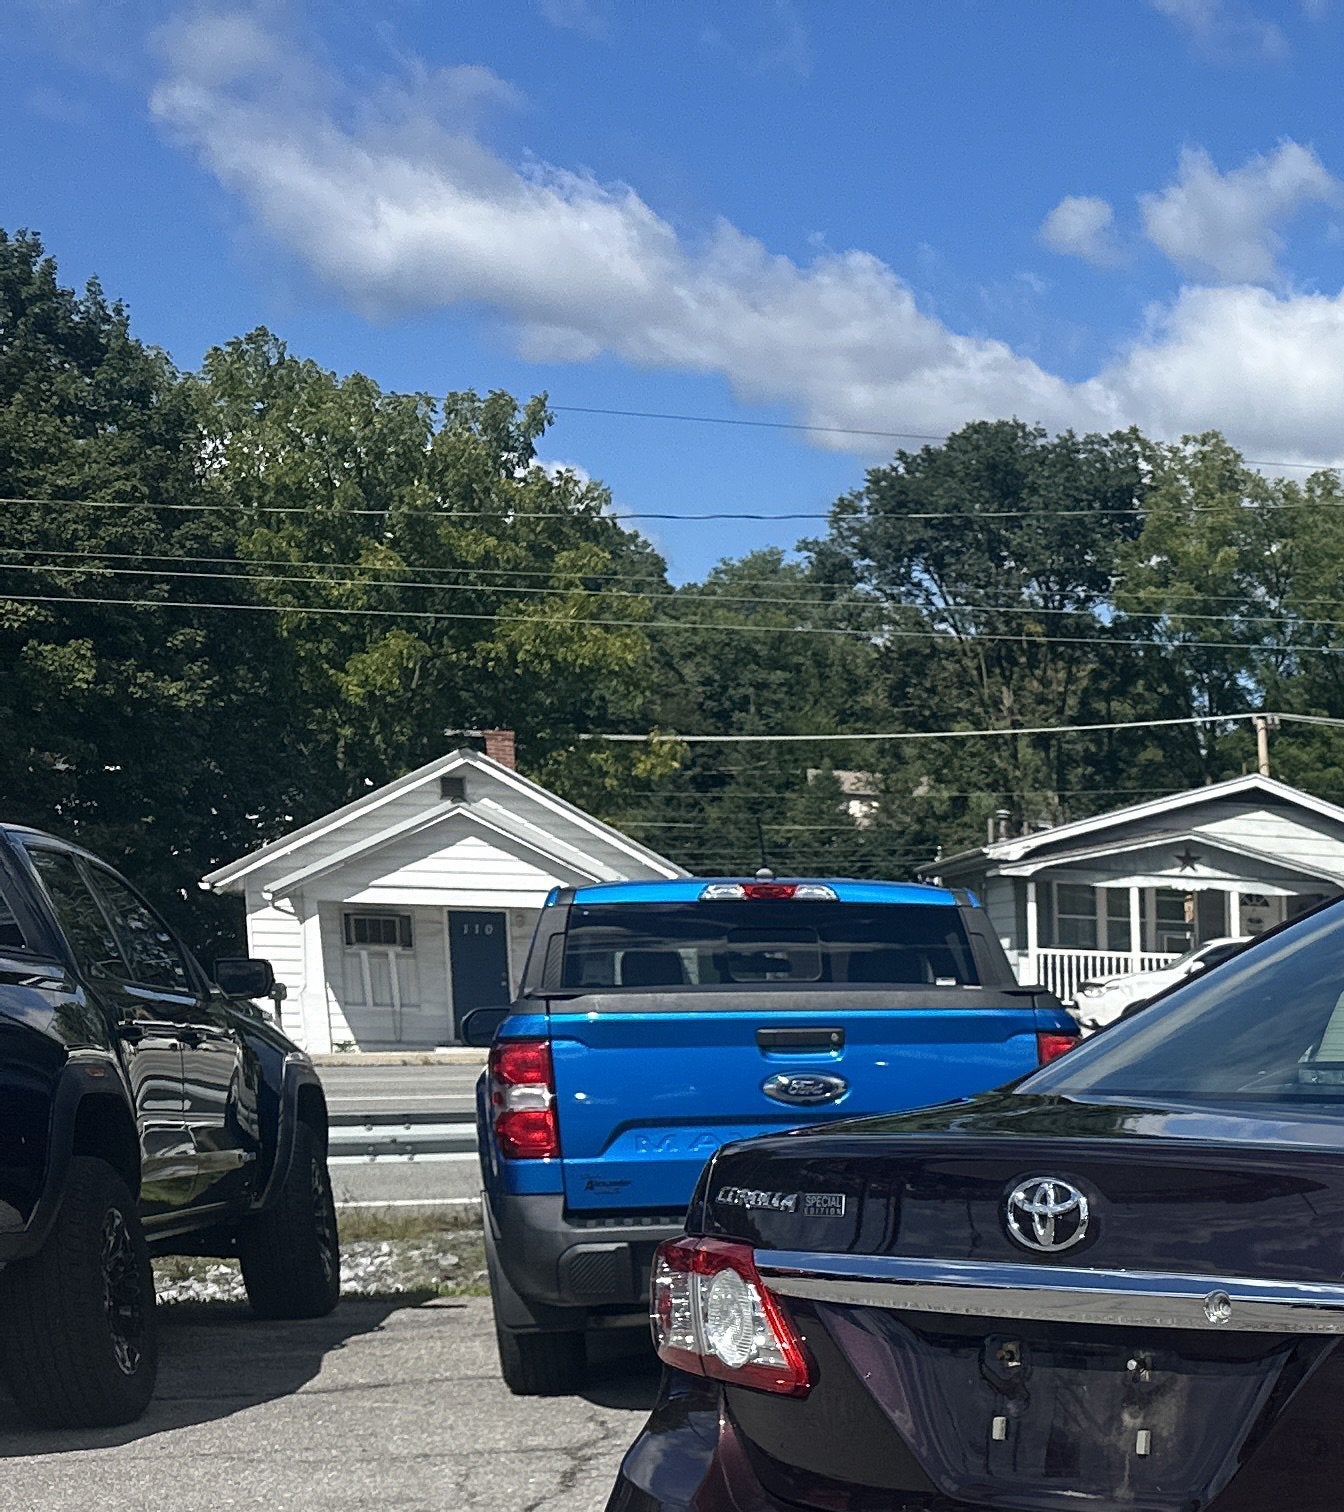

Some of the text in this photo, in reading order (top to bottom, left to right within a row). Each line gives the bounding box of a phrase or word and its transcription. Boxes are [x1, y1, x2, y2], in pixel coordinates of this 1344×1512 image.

[463, 923, 494, 936] 110
[804, 1195, 842, 1208] SPECIAL
[803, 1207, 842, 1216] EDITION
